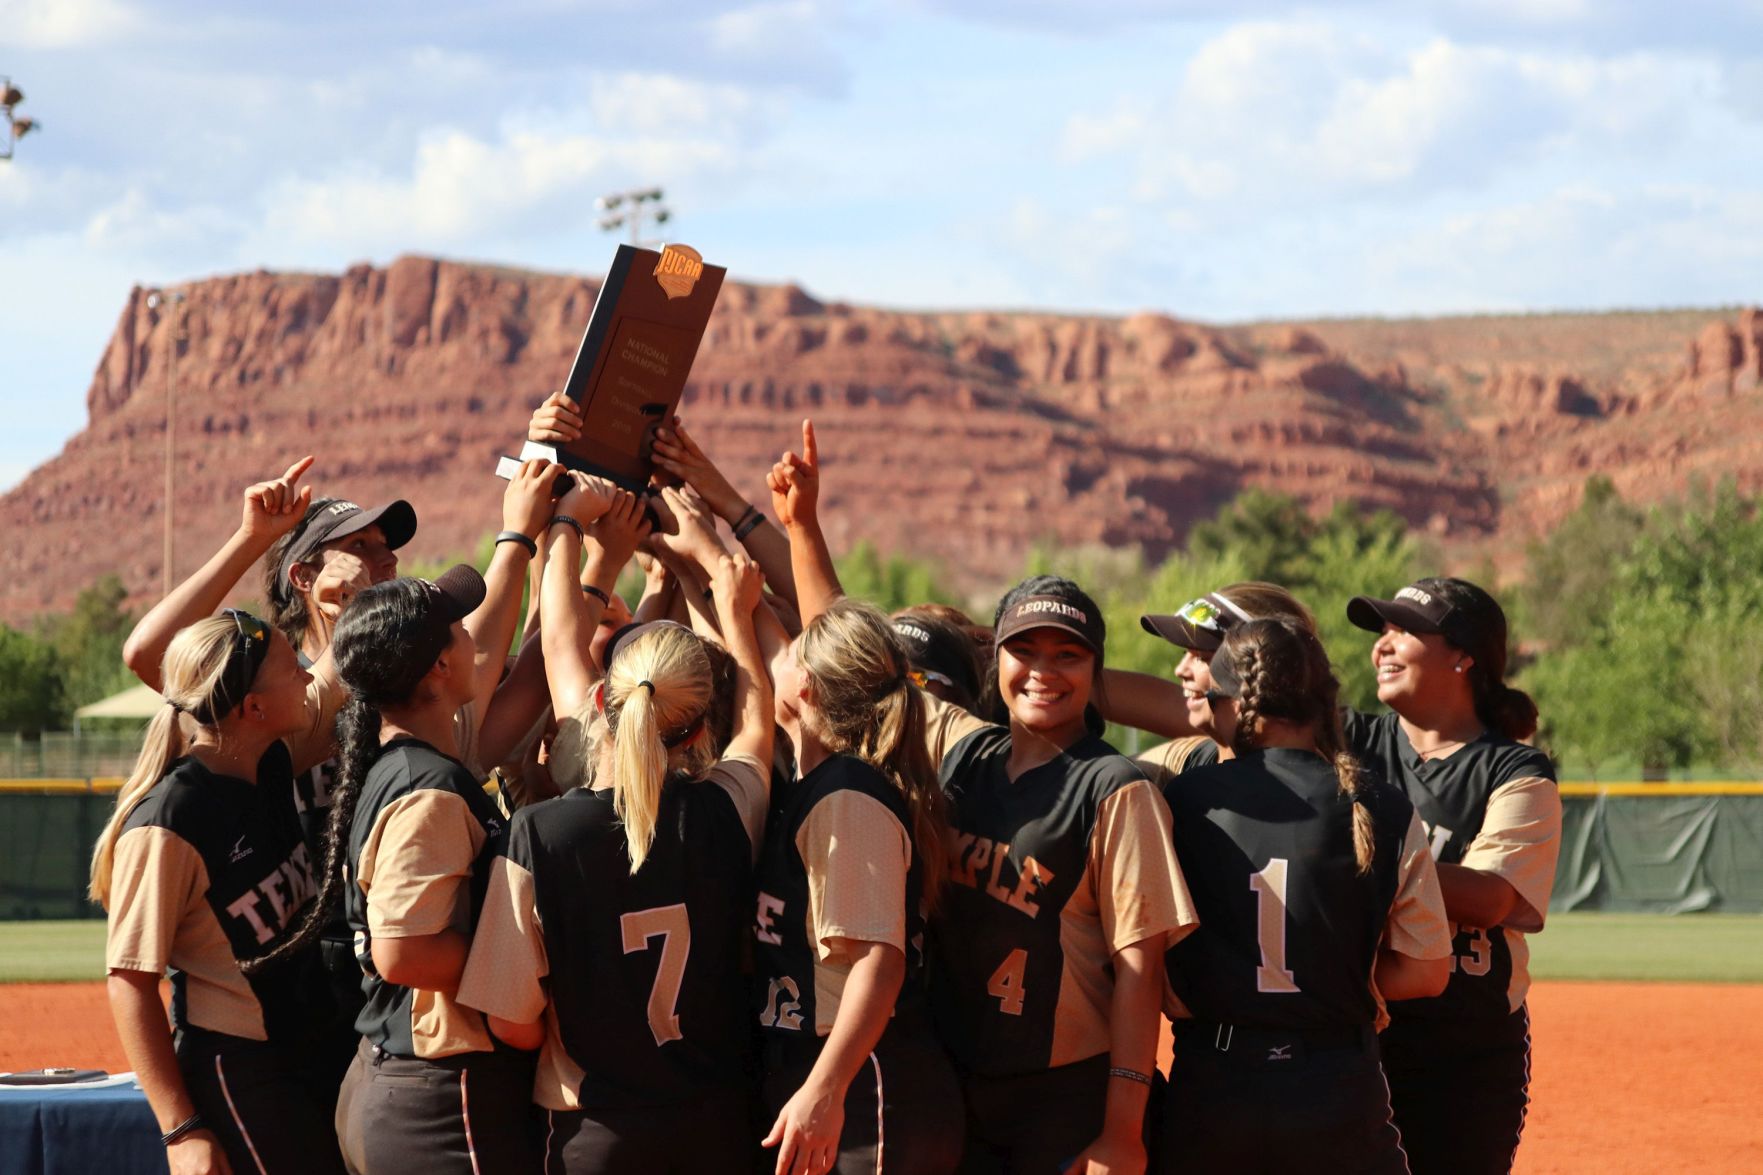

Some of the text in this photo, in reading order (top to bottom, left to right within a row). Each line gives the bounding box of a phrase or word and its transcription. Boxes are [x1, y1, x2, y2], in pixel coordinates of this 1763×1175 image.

[621, 349, 669, 377] CHAMPION
[627, 337, 671, 365] NATIONAL
[1016, 600, 1087, 625] LEOPARDS
[1249, 857, 1302, 993] 1
[619, 902, 691, 1048] 7
[759, 975, 806, 1031] 12
[986, 948, 1029, 1016] 4
